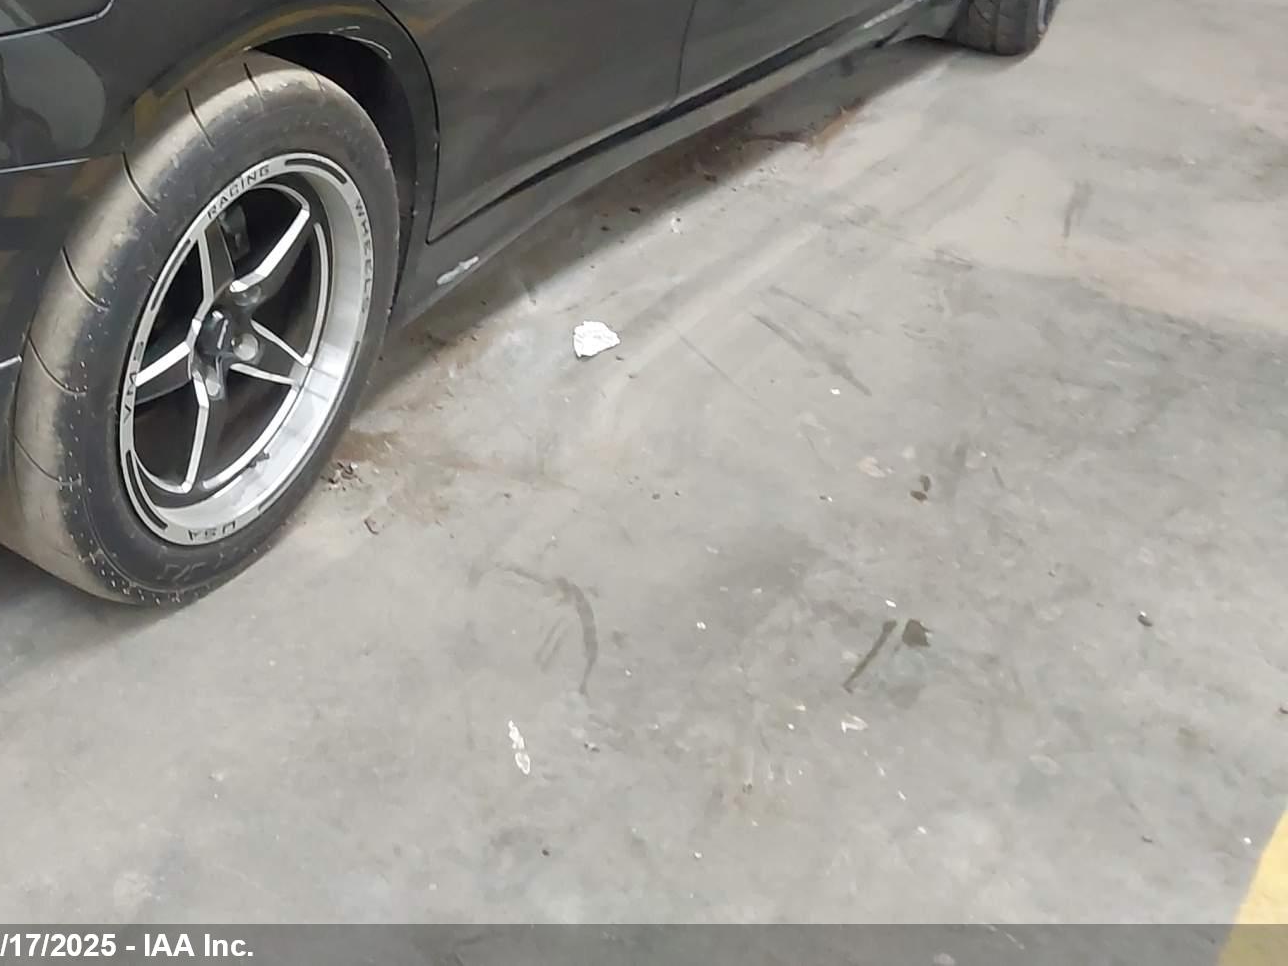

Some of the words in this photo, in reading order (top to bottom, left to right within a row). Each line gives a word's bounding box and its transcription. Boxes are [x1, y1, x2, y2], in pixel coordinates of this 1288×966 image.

[207, 165, 270, 220] RACING
[354, 198, 374, 315] WHEELS
[187, 519, 237, 541] USA
